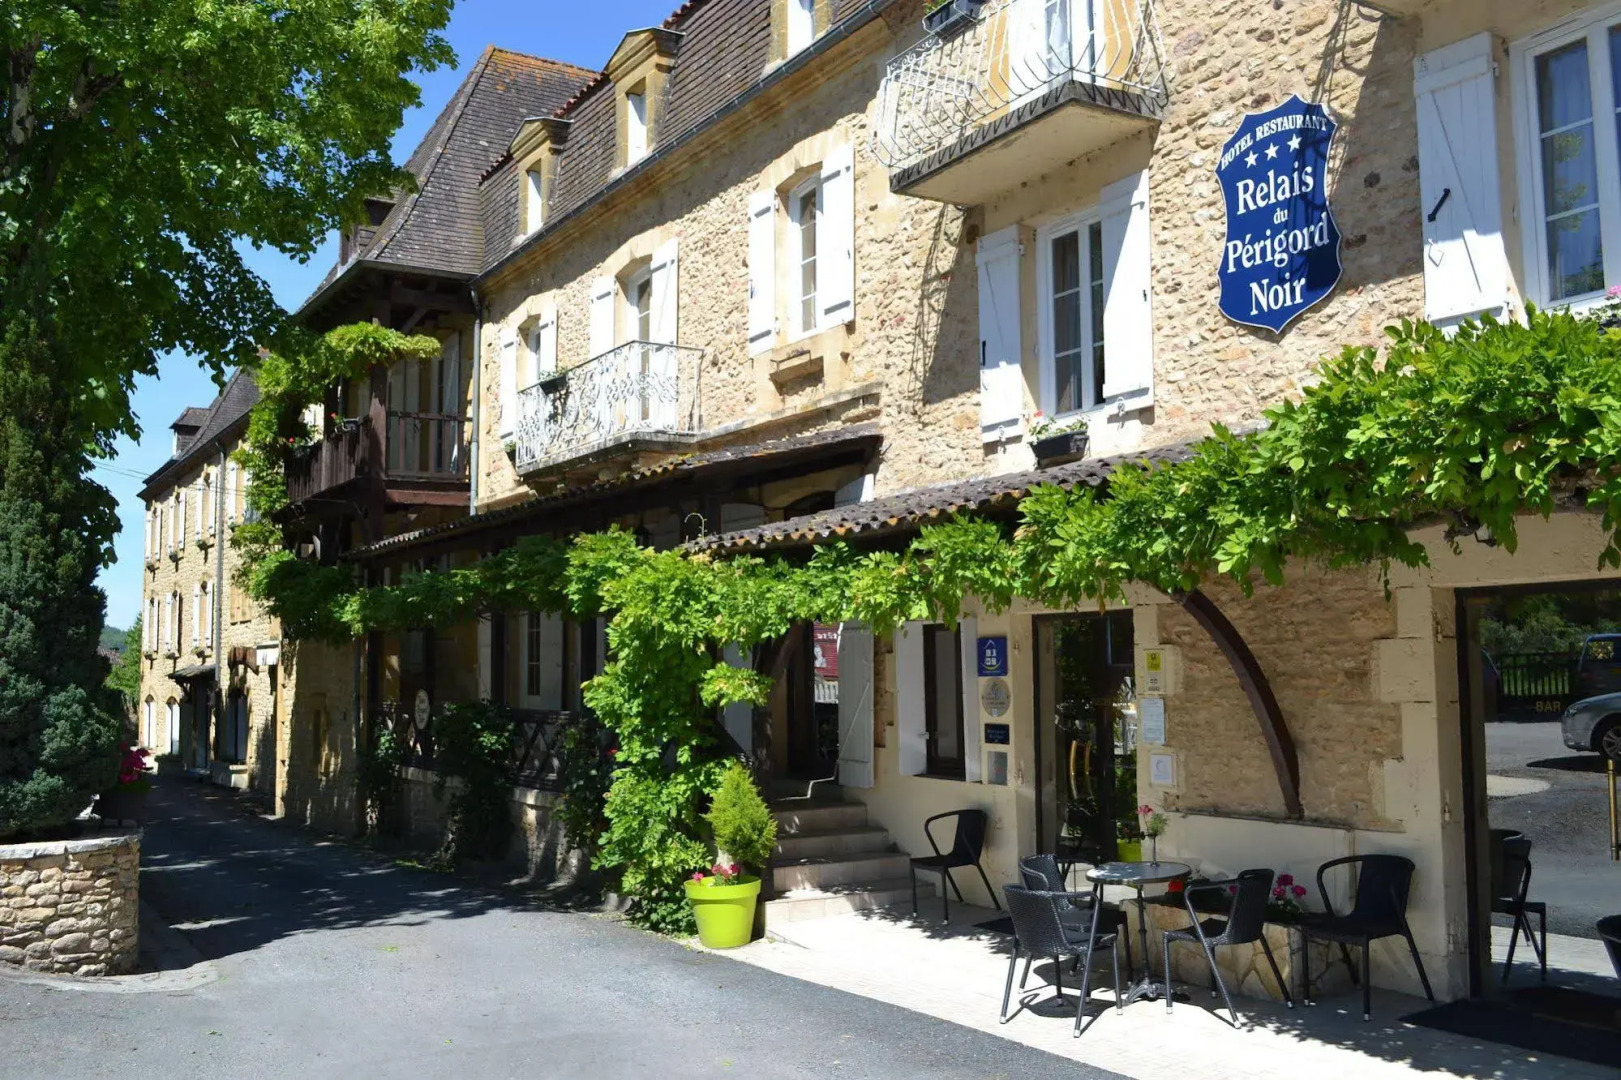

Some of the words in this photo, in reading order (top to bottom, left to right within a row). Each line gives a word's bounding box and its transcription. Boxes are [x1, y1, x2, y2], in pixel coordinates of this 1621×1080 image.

[1221, 132, 1254, 171] HOTEL
[1255, 114, 1328, 142] RESTAURANT
[1236, 161, 1314, 215] Relais
[1273, 207, 1289, 225] du
[1226, 211, 1330, 273] Périgord
[1249, 272, 1306, 316] Noir
[1535, 700, 1561, 713] BAR
